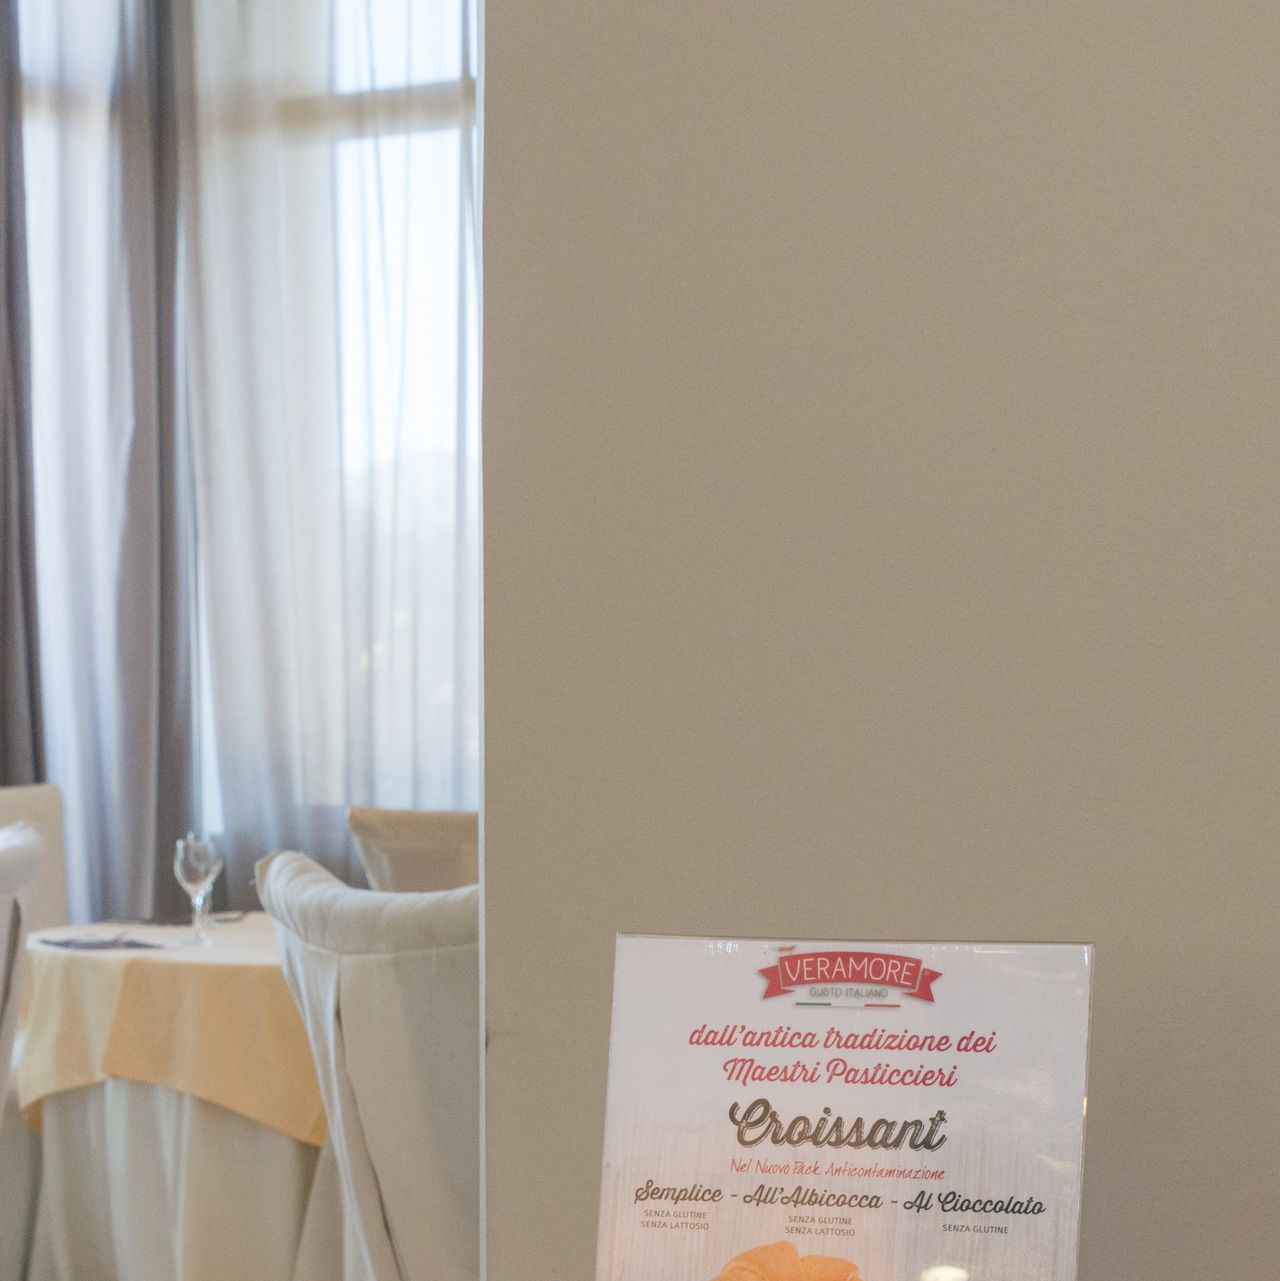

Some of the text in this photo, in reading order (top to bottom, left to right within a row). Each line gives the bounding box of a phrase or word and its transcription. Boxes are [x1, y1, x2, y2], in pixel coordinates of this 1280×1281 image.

[785, 956, 915, 986] VERAMORE
[809, 987, 889, 999] GUSTO ITALIANO
[688, 1024, 997, 1053] dall'antica tradizione dei
[722, 1057, 958, 1088] Maestri Pasticcieri
[728, 1098, 948, 1152] Croissant
[729, 1158, 946, 1181] Nel Nuovo Pack Anticontaminazione
[634, 1179, 723, 1205] Semplice
[742, 1183, 884, 1209] All'Albicocca
[903, 1190, 934, 1213] Al
[938, 1191, 1047, 1215] Cioccolato
[644, 1209, 707, 1219] SENZA GLUTINE
[788, 1215, 852, 1225] SENZA GLUTINE
[640, 1220, 709, 1231] SENZA LATTOSIO
[784, 1226, 856, 1237] SENZA LATTOSIO
[942, 1223, 1009, 1234] SENZA GLUTINE
